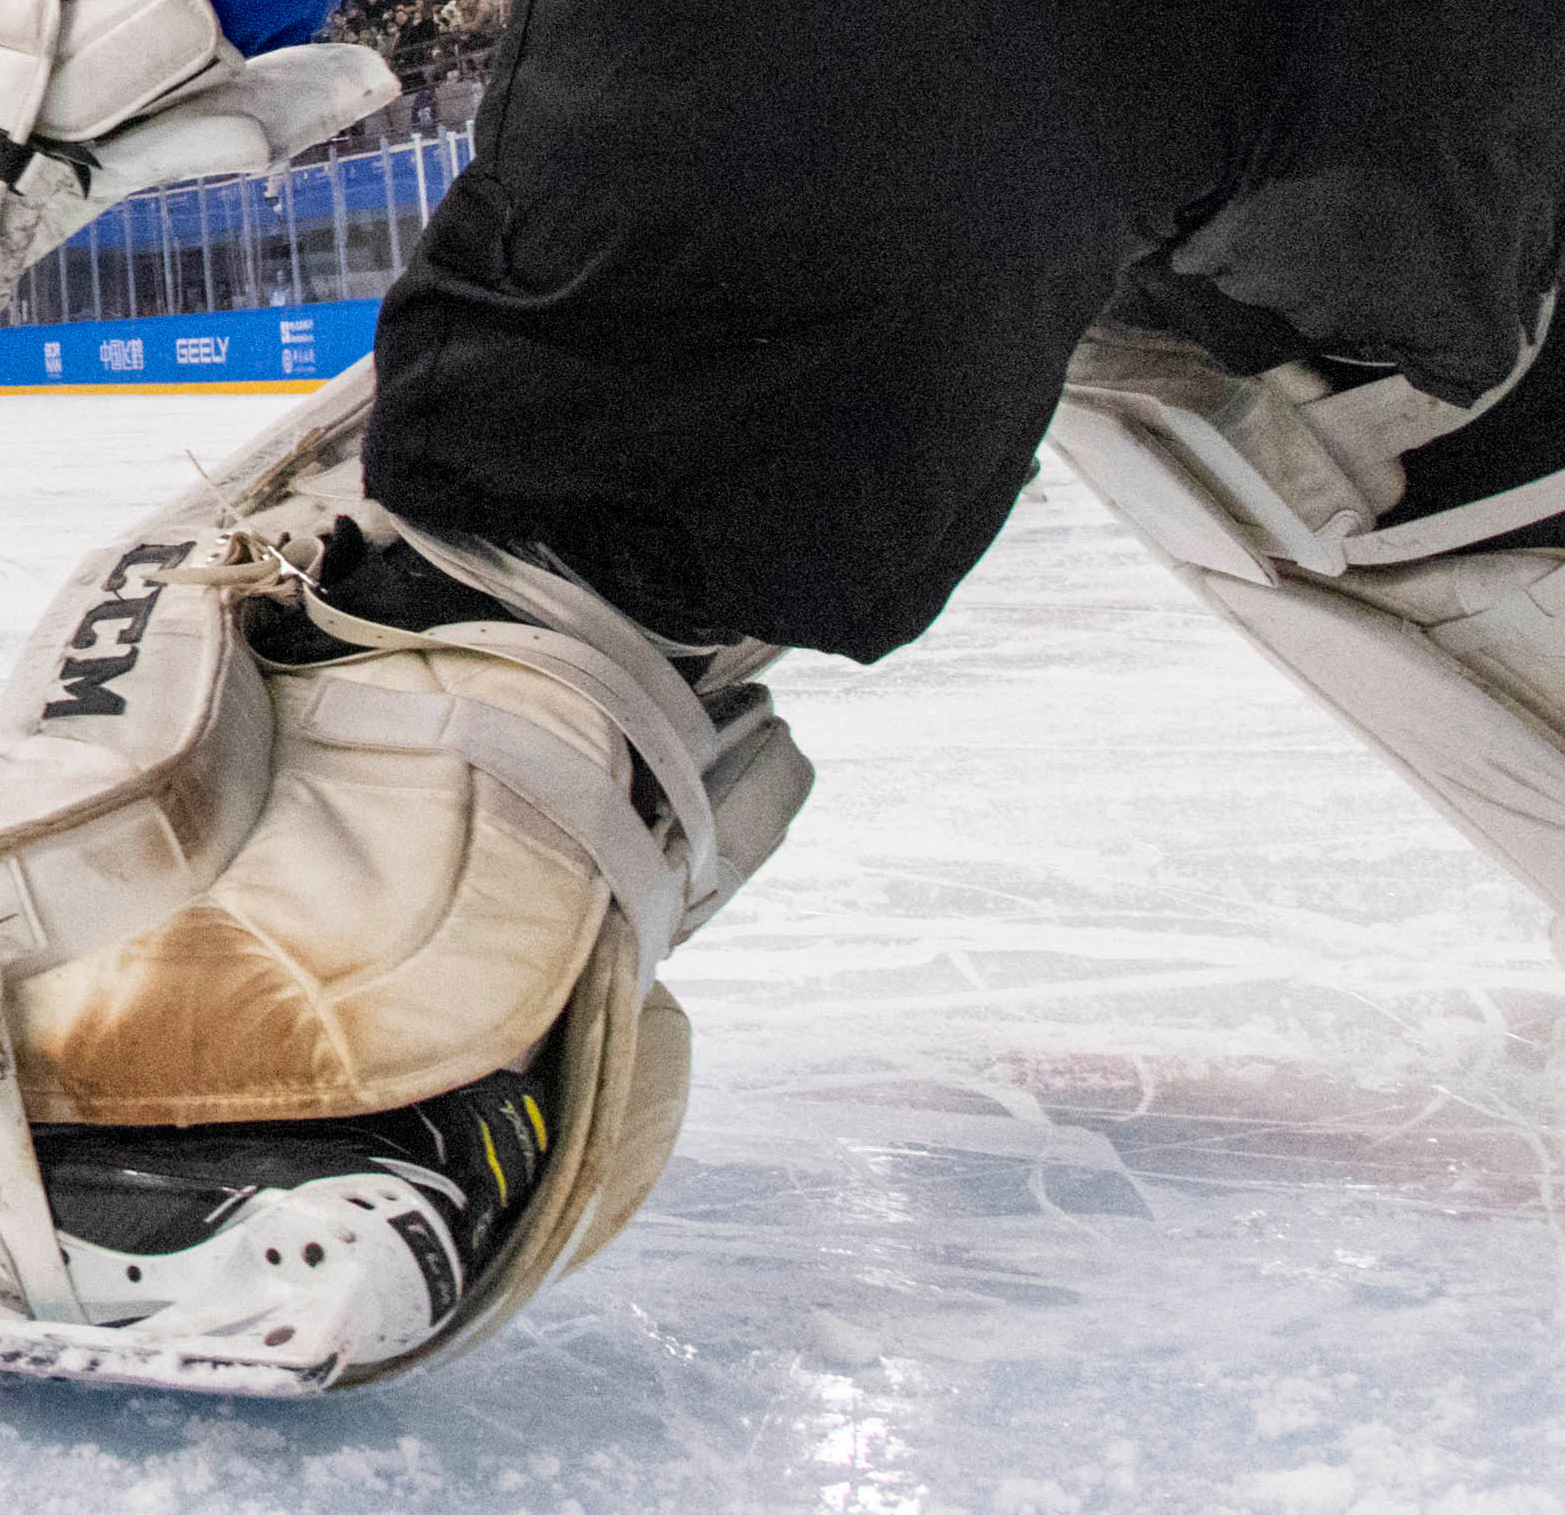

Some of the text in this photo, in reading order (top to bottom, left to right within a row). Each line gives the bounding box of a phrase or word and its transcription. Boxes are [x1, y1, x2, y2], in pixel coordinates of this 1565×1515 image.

[99, 337, 144, 371] 中国飞鹤
[175, 336, 230, 364] GEELY
[42, 540, 199, 721] CCM
